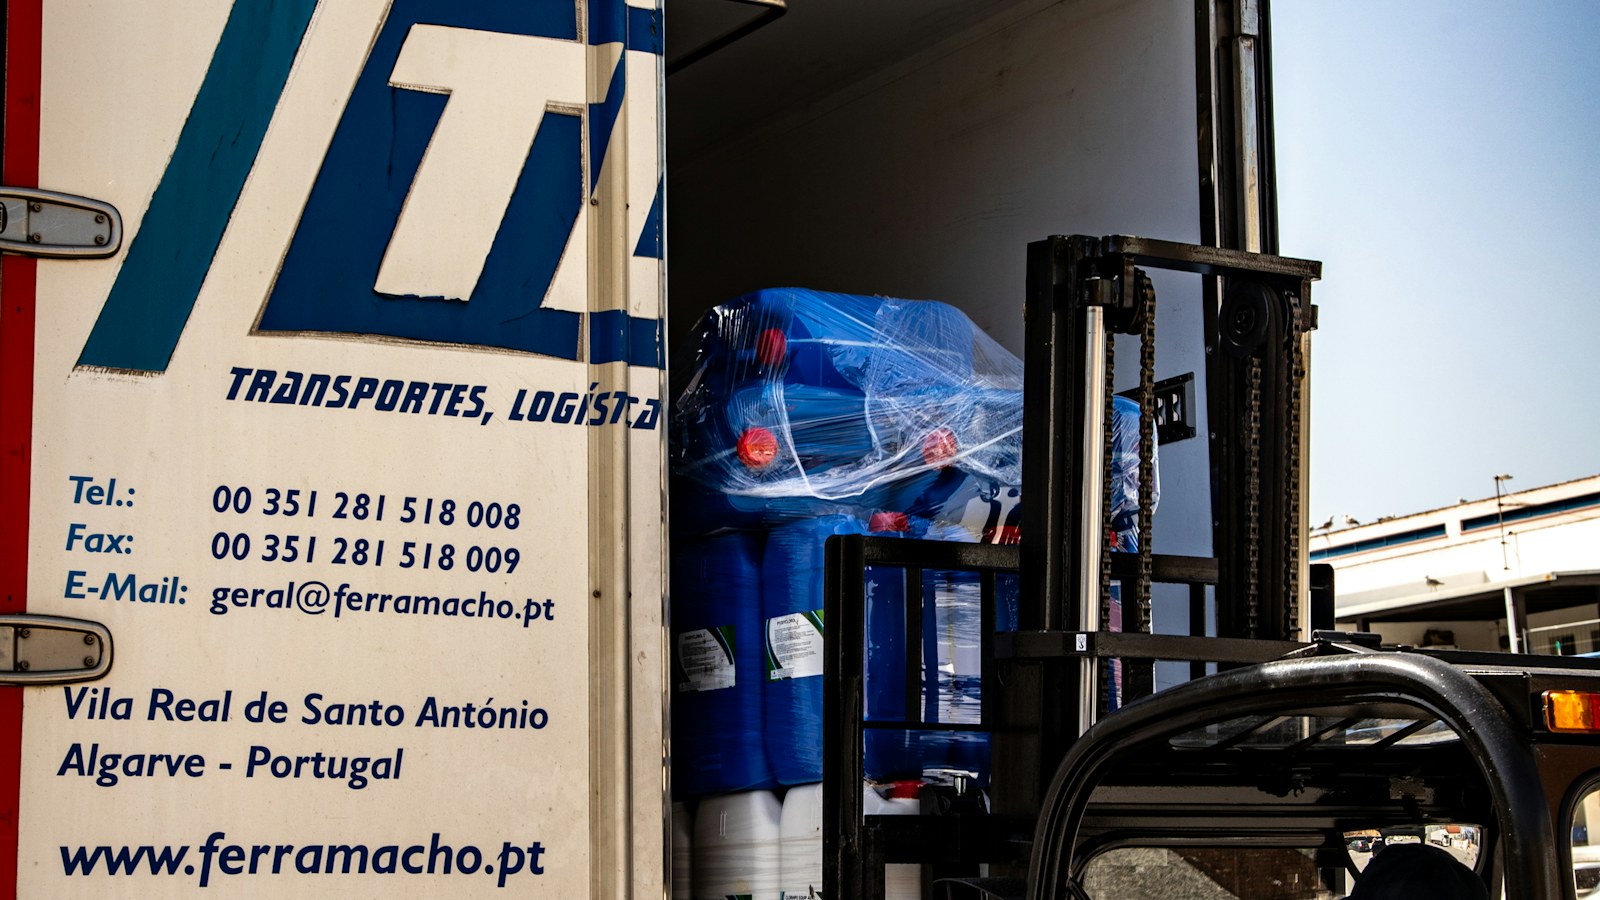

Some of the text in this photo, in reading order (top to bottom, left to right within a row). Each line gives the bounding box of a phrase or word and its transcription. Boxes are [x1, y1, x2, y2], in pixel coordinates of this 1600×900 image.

[226, 367, 495, 426] TRANSPORTES,
[68, 475, 521, 530] Tel.: 00 351 281 518 008
[65, 523, 521, 574] Fax: 00 351 281 518 009
[63, 570, 555, 628] E-Mail: geral@ferramacho.pt
[63, 687, 549, 730] Vila Real de Santo António
[56, 742, 206, 788] Algarve
[245, 745, 404, 790] Portugal
[59, 831, 546, 888] www.ferramacho.pt
